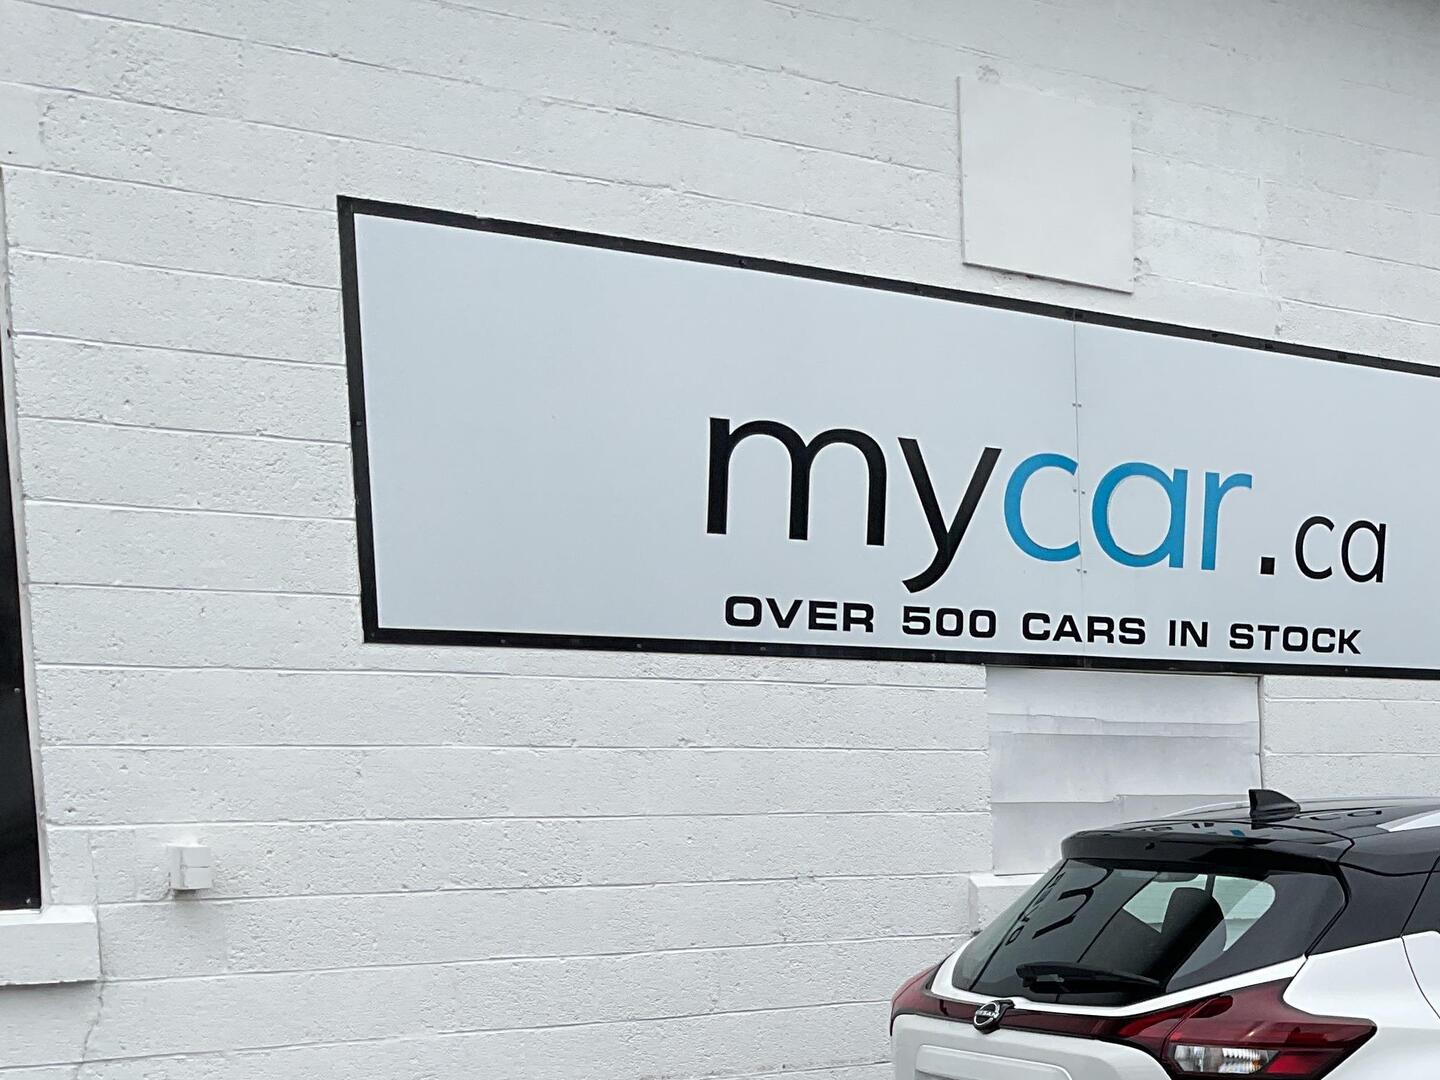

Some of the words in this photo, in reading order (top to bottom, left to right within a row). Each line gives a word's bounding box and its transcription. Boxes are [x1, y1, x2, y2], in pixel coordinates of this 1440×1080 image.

[706, 417, 1388, 593] mycar.ca
[724, 596, 875, 634] OVER
[902, 606, 997, 639] 500
[1021, 612, 1147, 645] CARS
[1168, 620, 1208, 648] IN
[1229, 623, 1362, 655] STOCK
